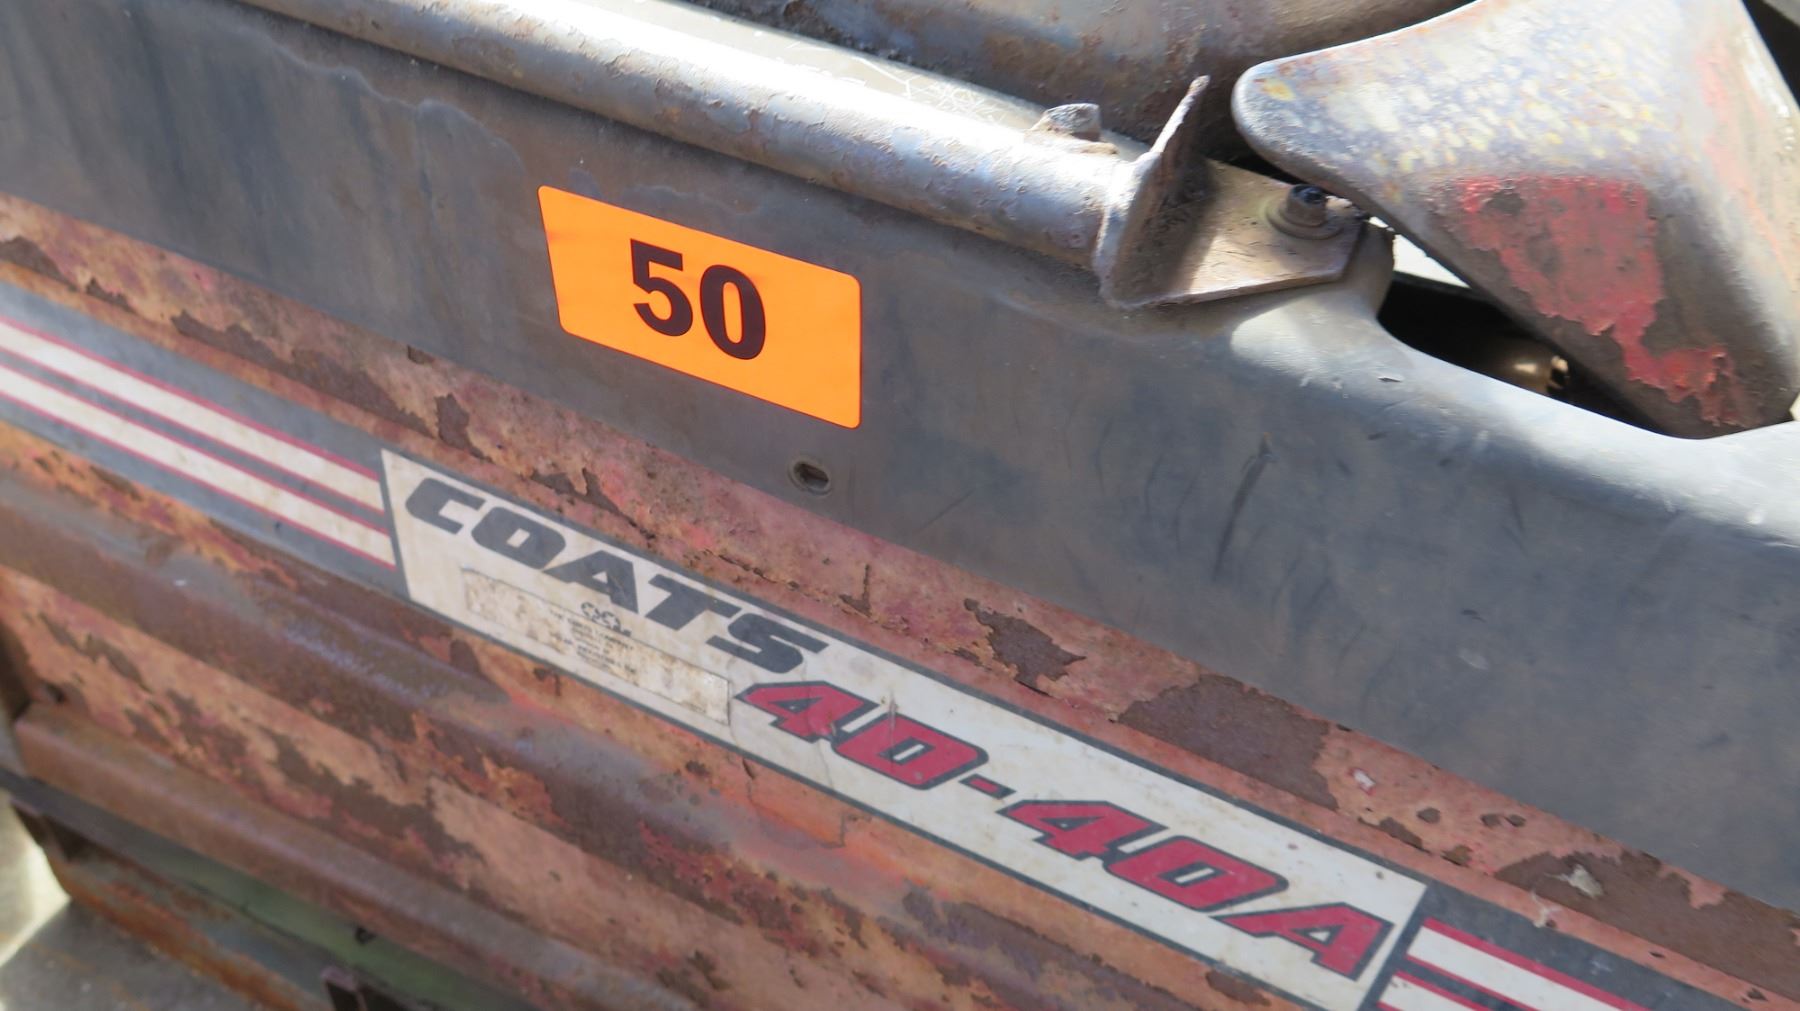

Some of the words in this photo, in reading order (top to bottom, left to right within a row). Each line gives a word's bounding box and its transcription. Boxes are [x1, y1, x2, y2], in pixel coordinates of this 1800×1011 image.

[629, 239, 766, 360] 50
[405, 477, 829, 674] COATS
[735, 680, 1394, 980] 40-40A
